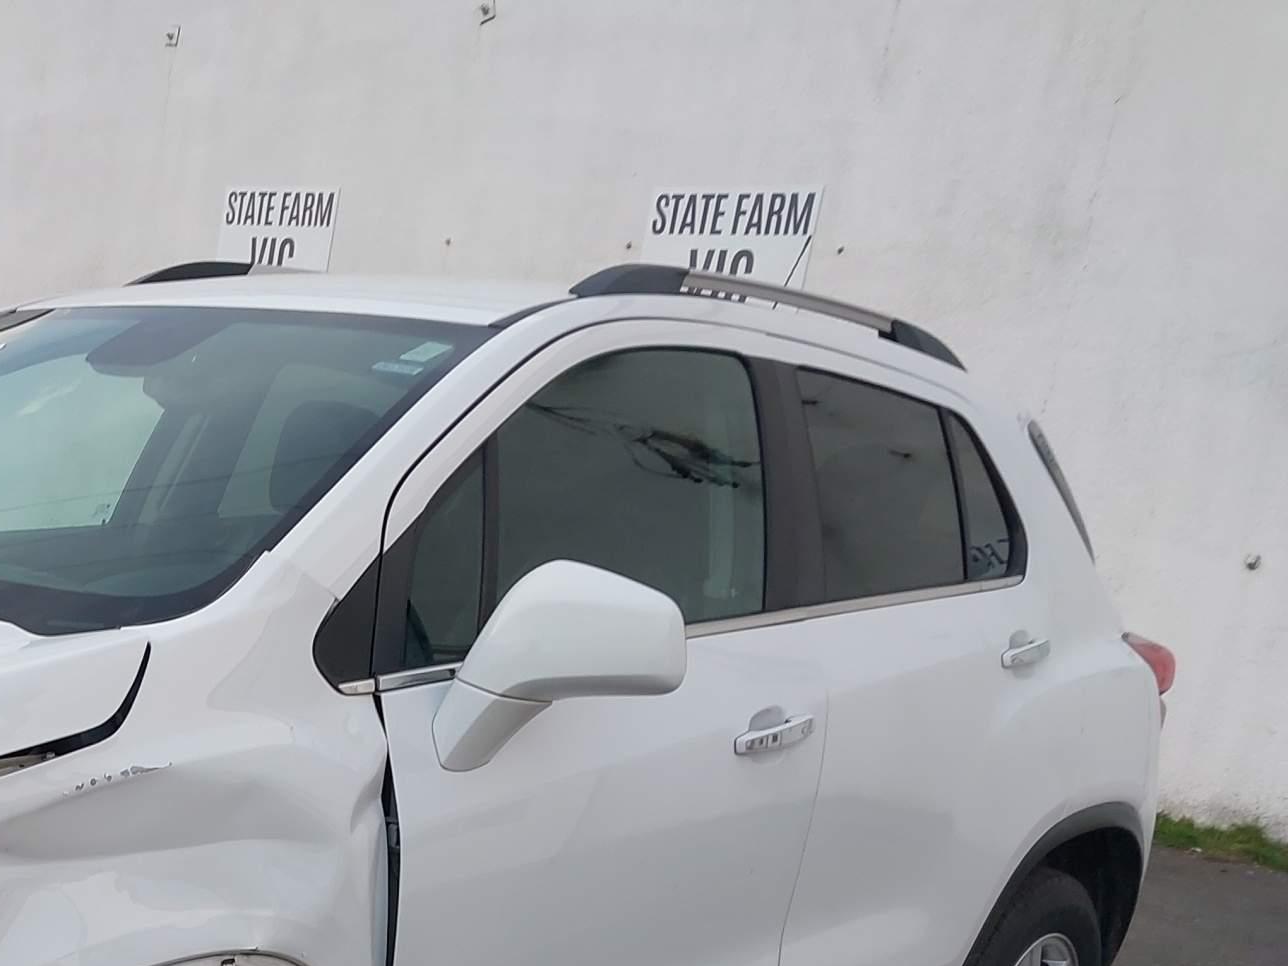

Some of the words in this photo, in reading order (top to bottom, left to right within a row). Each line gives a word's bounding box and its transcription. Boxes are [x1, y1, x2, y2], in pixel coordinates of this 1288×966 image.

[225, 191, 277, 226] STATE
[278, 192, 336, 228] FARM
[652, 192, 729, 236] STATE
[730, 191, 816, 236] FARM
